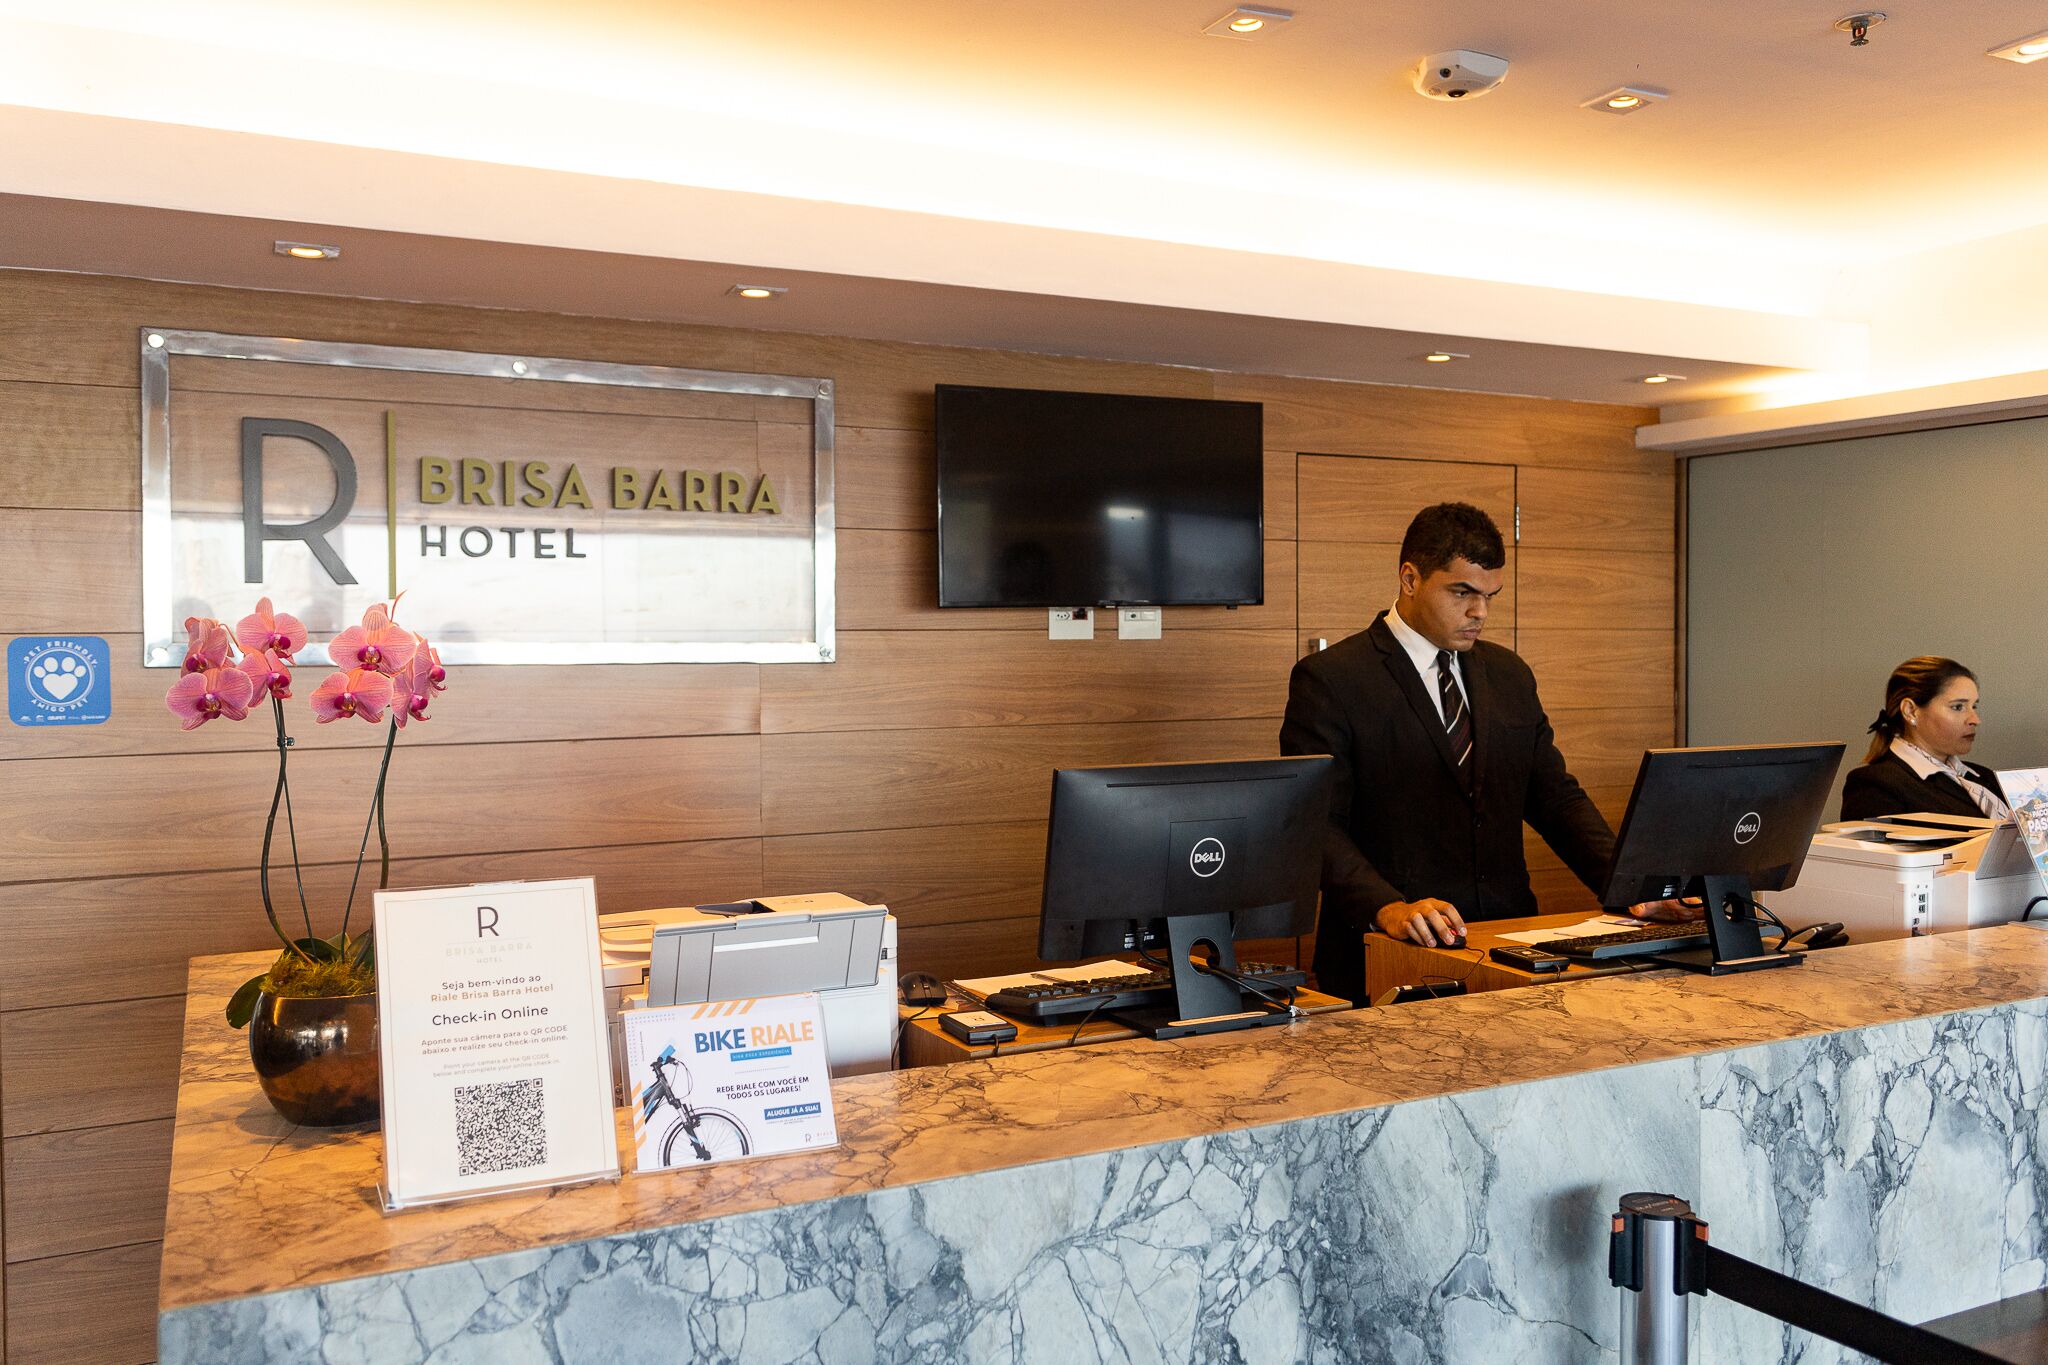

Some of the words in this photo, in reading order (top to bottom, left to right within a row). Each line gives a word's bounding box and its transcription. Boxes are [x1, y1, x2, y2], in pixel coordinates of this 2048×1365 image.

[418, 455, 593, 509] BRISA
[611, 466, 782, 514] BARRA
[241, 416, 359, 585] R
[420, 524, 587, 559] HOTEL
[23, 645, 42, 662] PET
[46, 640, 98, 665] FRIENDLY
[31, 698, 66, 713] AMIGO
[70, 697, 88, 711] PET
[1737, 824, 1757, 833] DELL
[1194, 851, 1222, 864] DELL
[477, 906, 500, 938] R
[446, 946, 484, 957] BRISA
[490, 942, 533, 954] BARRA
[476, 956, 503, 964] HOTEL
[442, 982, 465, 991] Seja
[468, 975, 525, 988] bem-vindo
[431, 992, 458, 1002] Riale
[461, 990, 490, 1000] Brisa
[492, 987, 522, 997] Barra
[525, 984, 554, 994] Hotel
[432, 1010, 497, 1026] Check-in
[501, 1006, 549, 1020] Online
[421, 1037, 452, 1046] Aponte
[470, 1031, 501, 1041] câmera
[503, 1030, 521, 1039] para
[544, 1024, 568, 1034] CODE
[694, 1028, 747, 1054] BIKE
[751, 1020, 815, 1048] RIALE
[422, 1046, 450, 1055] abaixo
[459, 1042, 487, 1051] realize
[488, 1040, 503, 1048] seu
[504, 1037, 540, 1047] check-in
[716, 1086, 735, 1094] REDE
[736, 1082, 757, 1091] RIALE
[758, 1080, 776, 1089] COM
[777, 1075, 798, 1086] VOCÊ
[726, 1091, 753, 1100] TODOS
[753, 1089, 765, 1097] OS
[766, 1085, 801, 1095] LUGARES!
[766, 1107, 790, 1116] ALUGUE
[790, 1104, 800, 1114] JÁ
[799, 1105, 806, 1113] A
[804, 1103, 820, 1111] SUA!
